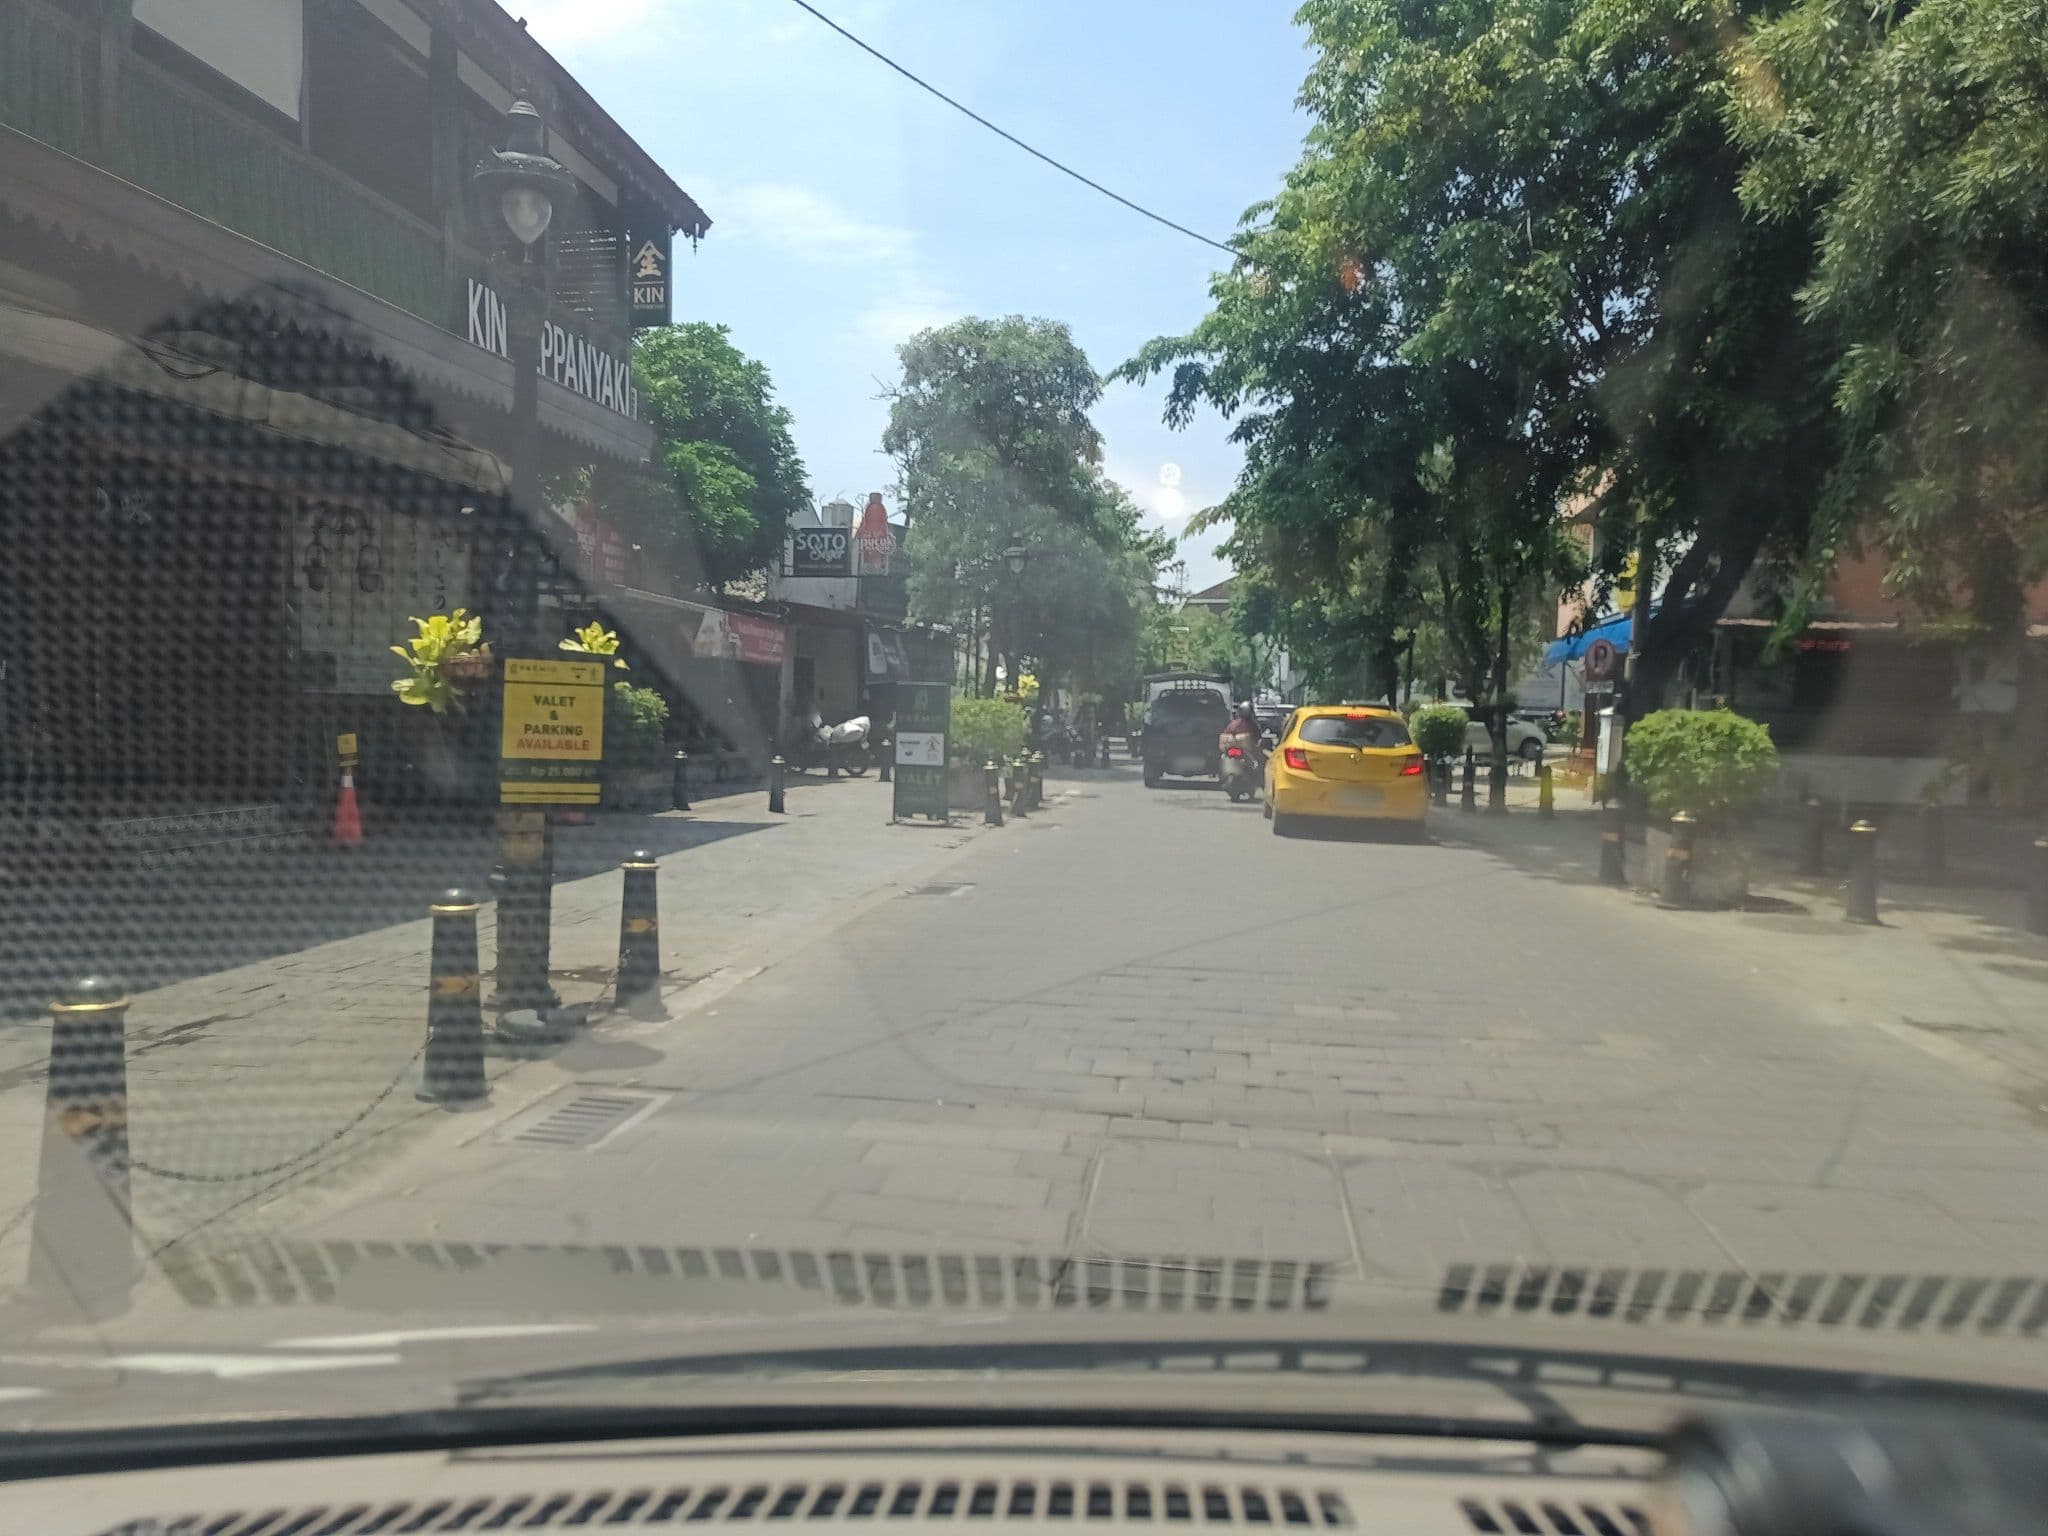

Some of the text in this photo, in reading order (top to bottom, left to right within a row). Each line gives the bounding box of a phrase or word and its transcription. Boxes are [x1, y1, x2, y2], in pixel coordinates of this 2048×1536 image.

[634, 287, 665, 304] KIN
[468, 278, 630, 417] KIN PPANYAKI
[796, 533, 847, 550] SOTO
[533, 695, 576, 708] VALET
[550, 710, 558, 720] &
[523, 723, 584, 736] PARKING
[517, 739, 590, 751] AVAILABLE
